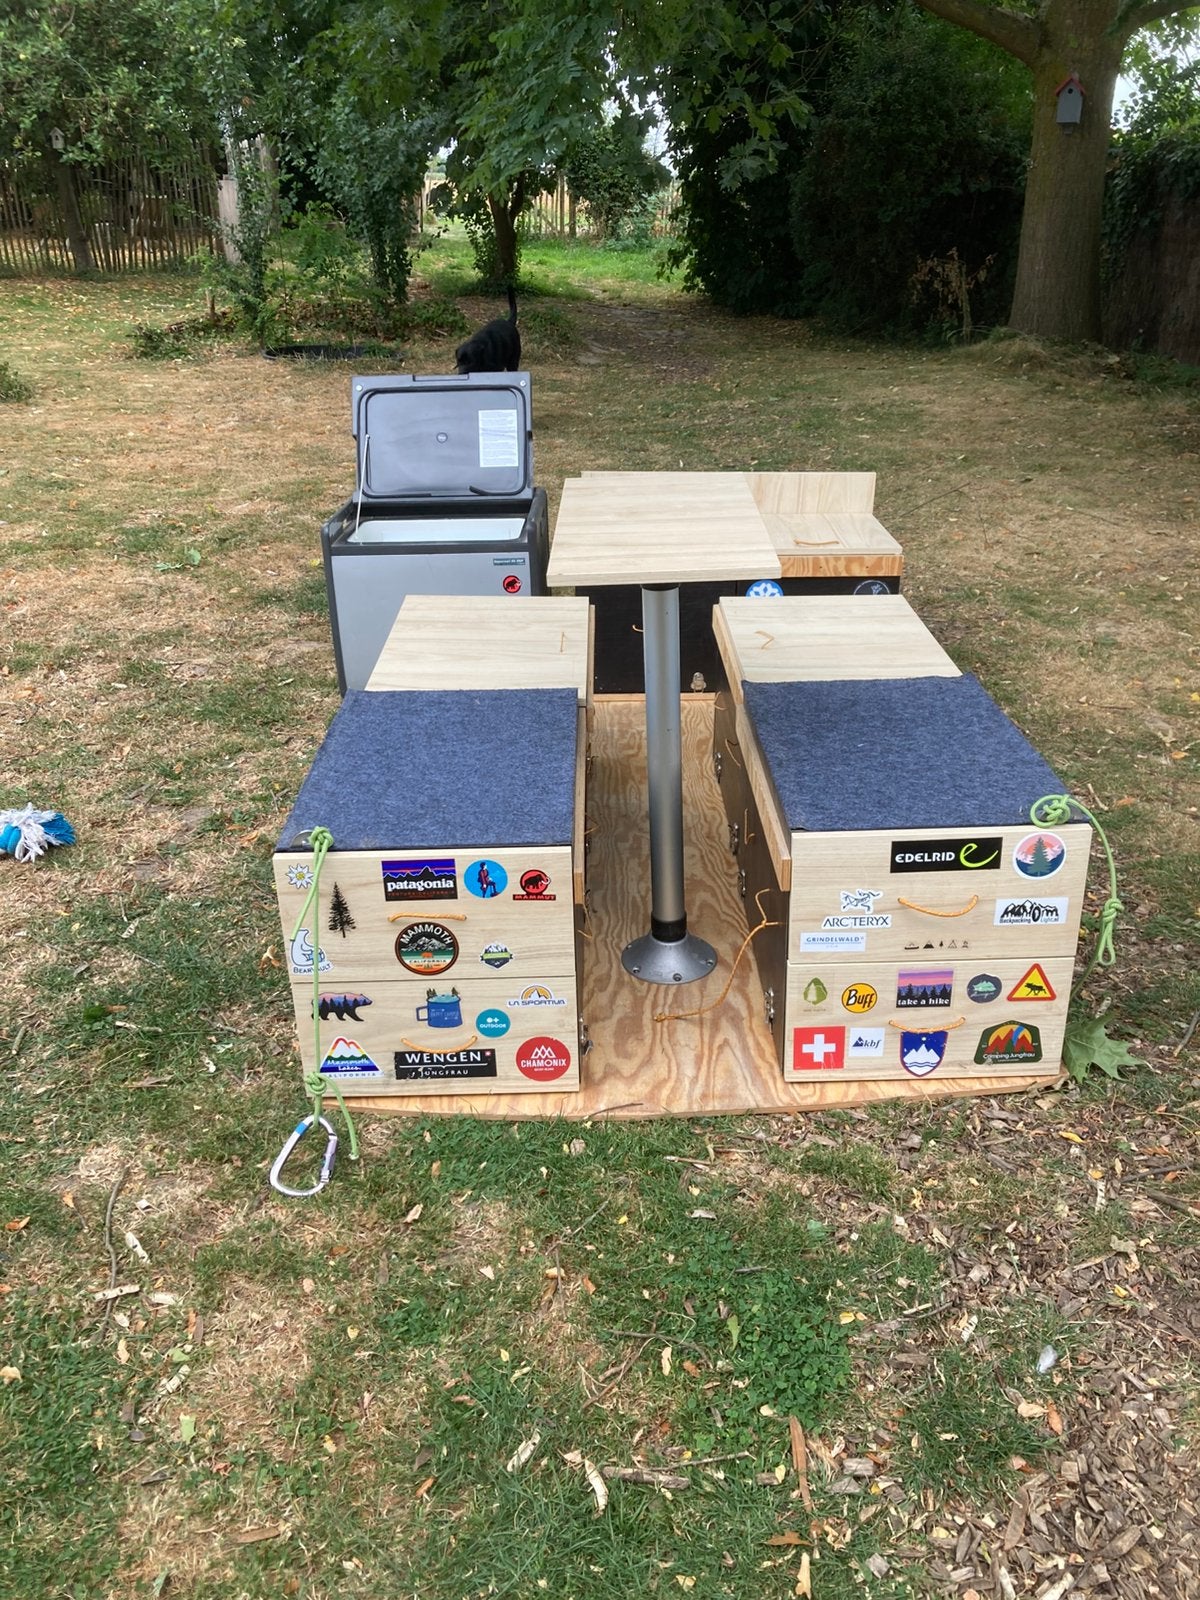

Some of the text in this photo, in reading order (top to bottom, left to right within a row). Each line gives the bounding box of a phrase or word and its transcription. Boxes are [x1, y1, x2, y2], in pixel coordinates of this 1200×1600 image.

[895, 851, 956, 864] EDELRID
[386, 878, 455, 892] patagonia
[400, 924, 453, 944] MAMMOTH
[846, 989, 875, 1008] Buff
[405, 1051, 481, 1064] WENGEN
[520, 1058, 567, 1068] CHAMONIX
